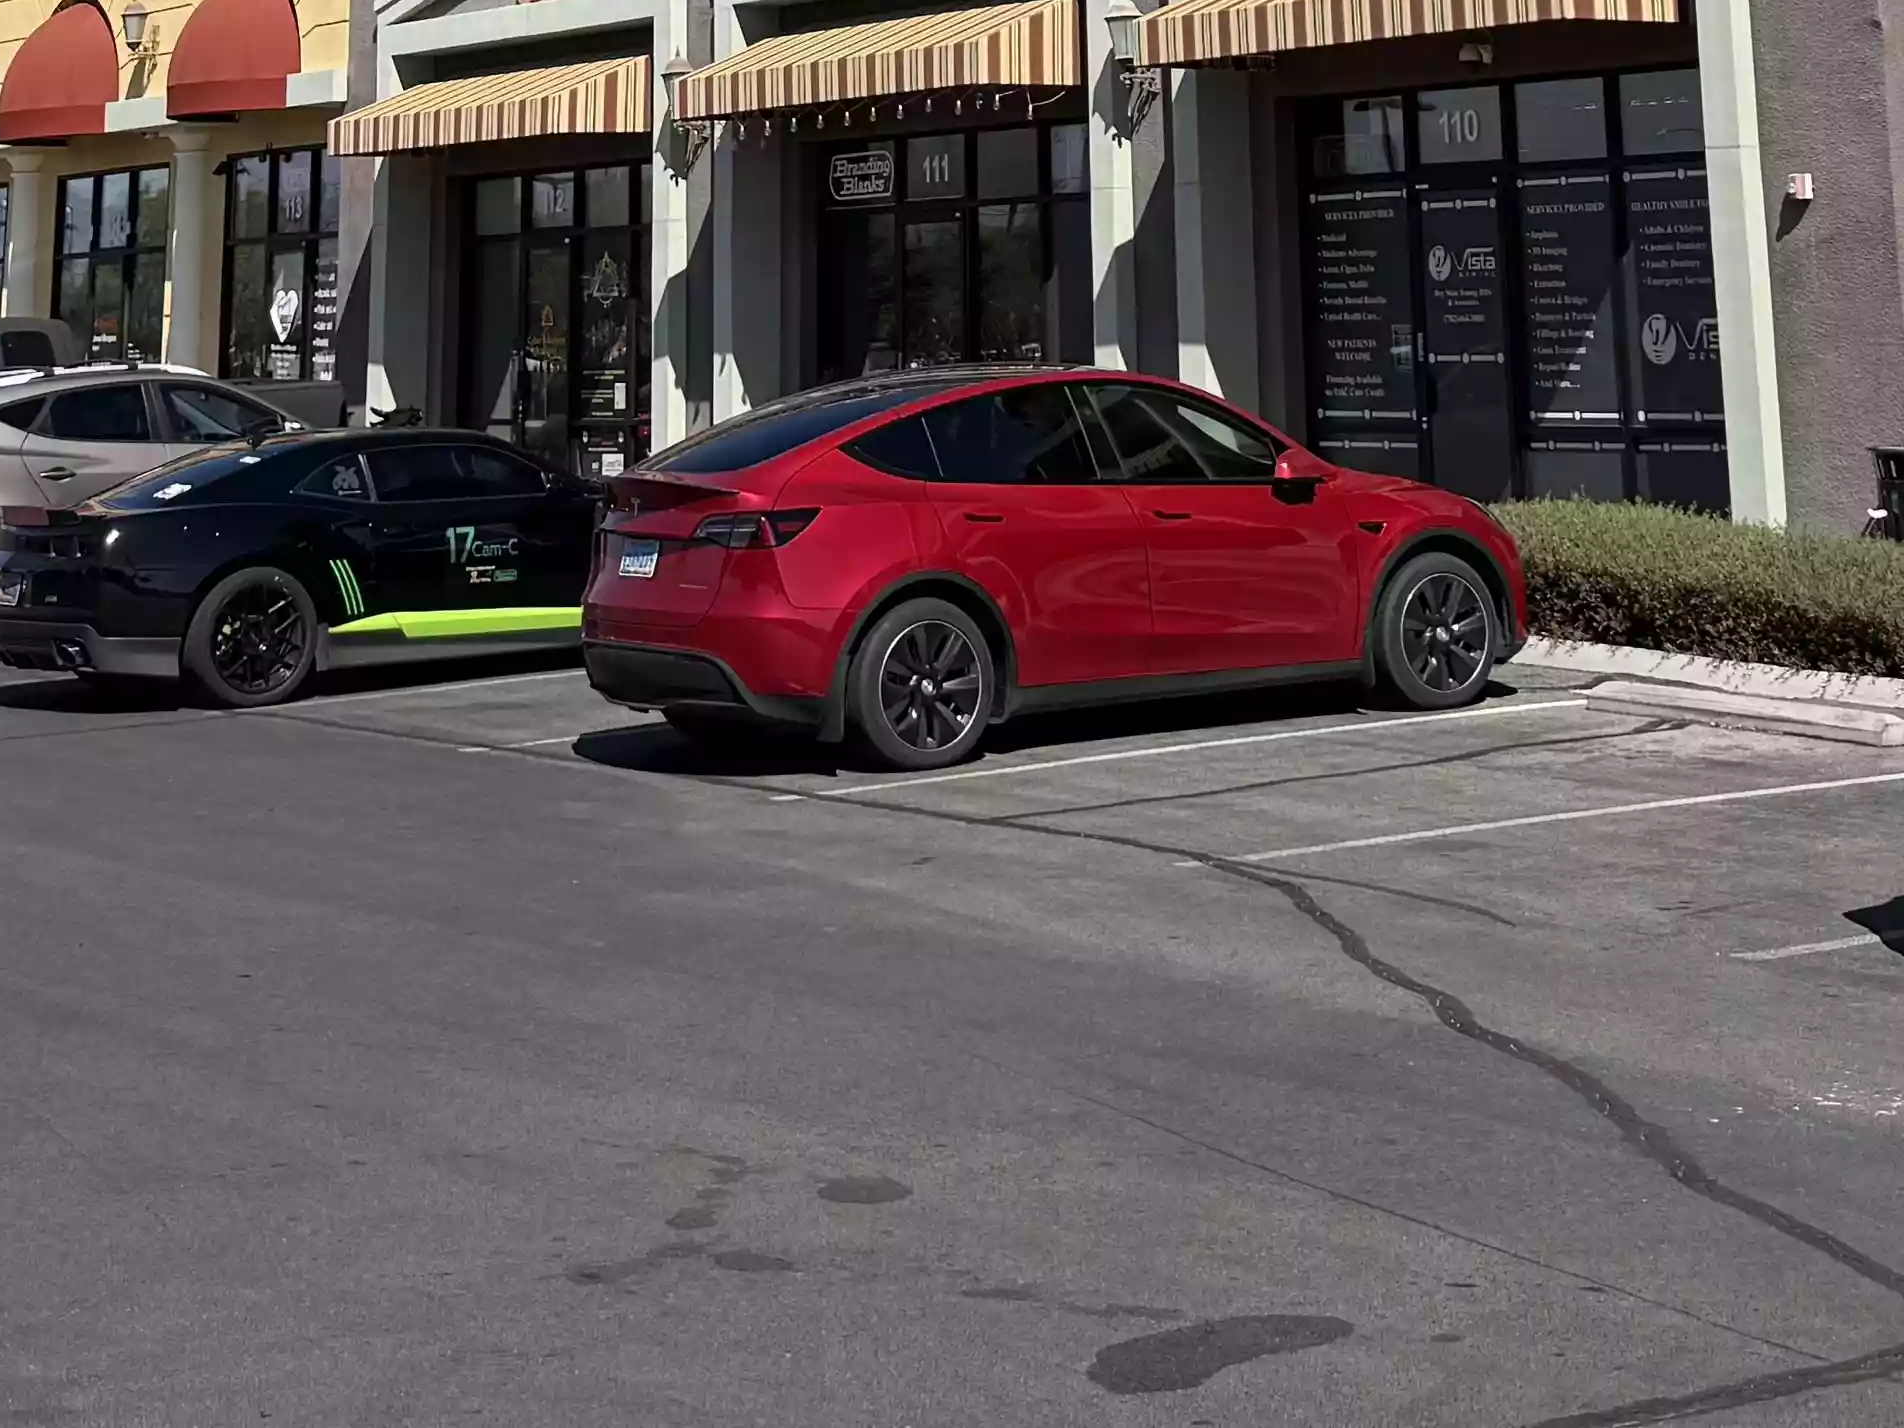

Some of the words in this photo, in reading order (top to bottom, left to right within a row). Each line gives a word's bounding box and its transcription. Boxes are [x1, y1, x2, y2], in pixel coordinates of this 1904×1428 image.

[1439, 108, 1479, 144] 110
[923, 153, 949, 183] 111
[1451, 247, 1496, 270] Vista
[446, 526, 475, 563] 17
